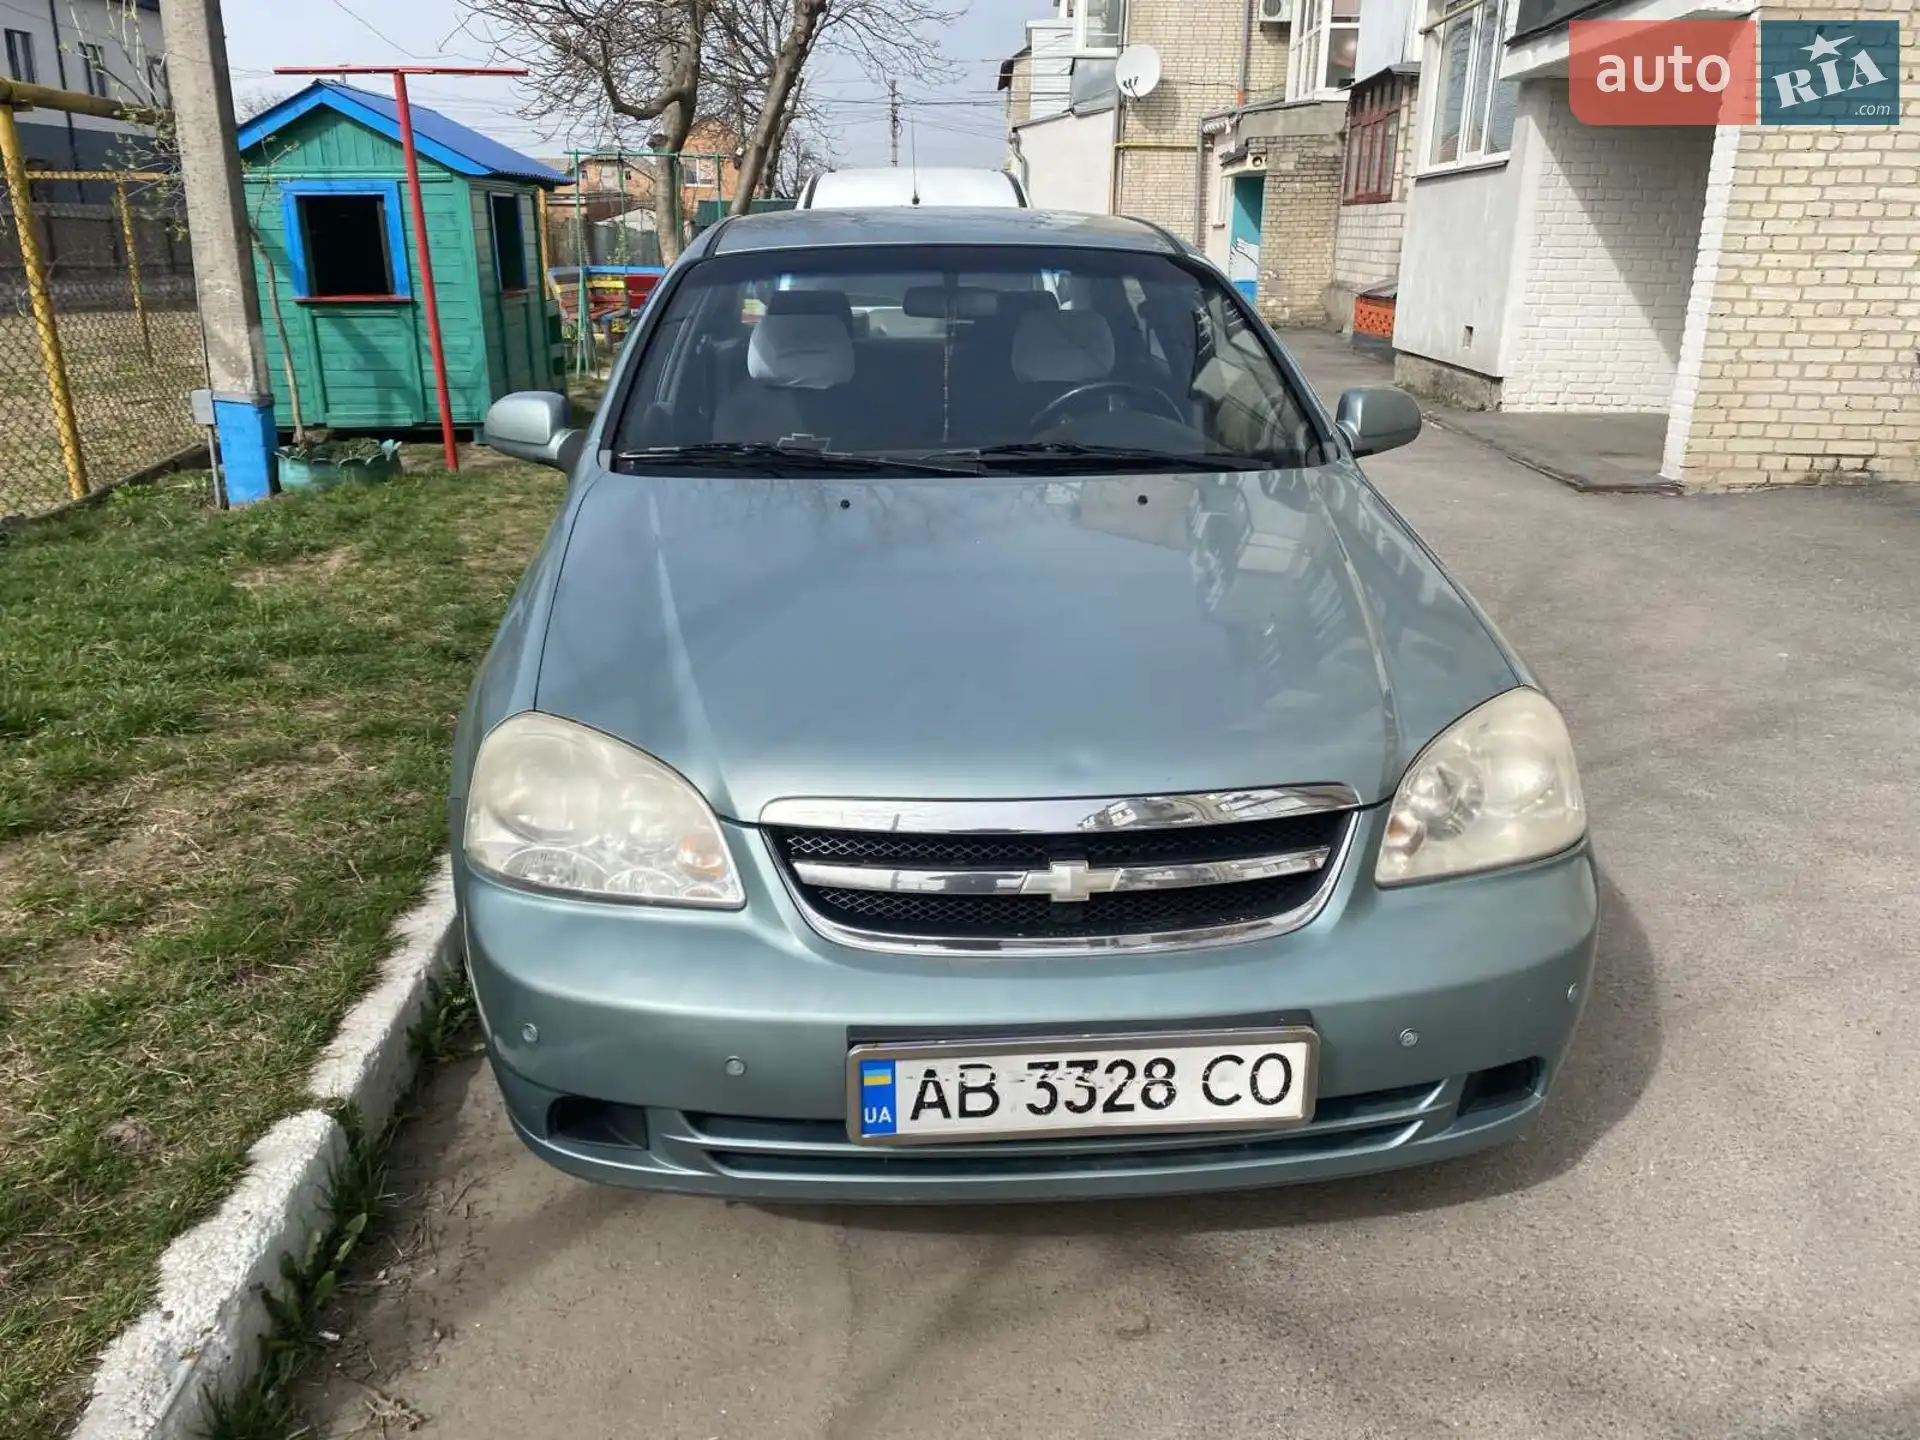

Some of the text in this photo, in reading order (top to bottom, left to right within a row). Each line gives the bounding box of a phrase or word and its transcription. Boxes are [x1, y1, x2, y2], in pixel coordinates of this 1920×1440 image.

[910, 1052, 1292, 1121] AB 3328 CO
[864, 1106, 893, 1125] UA
